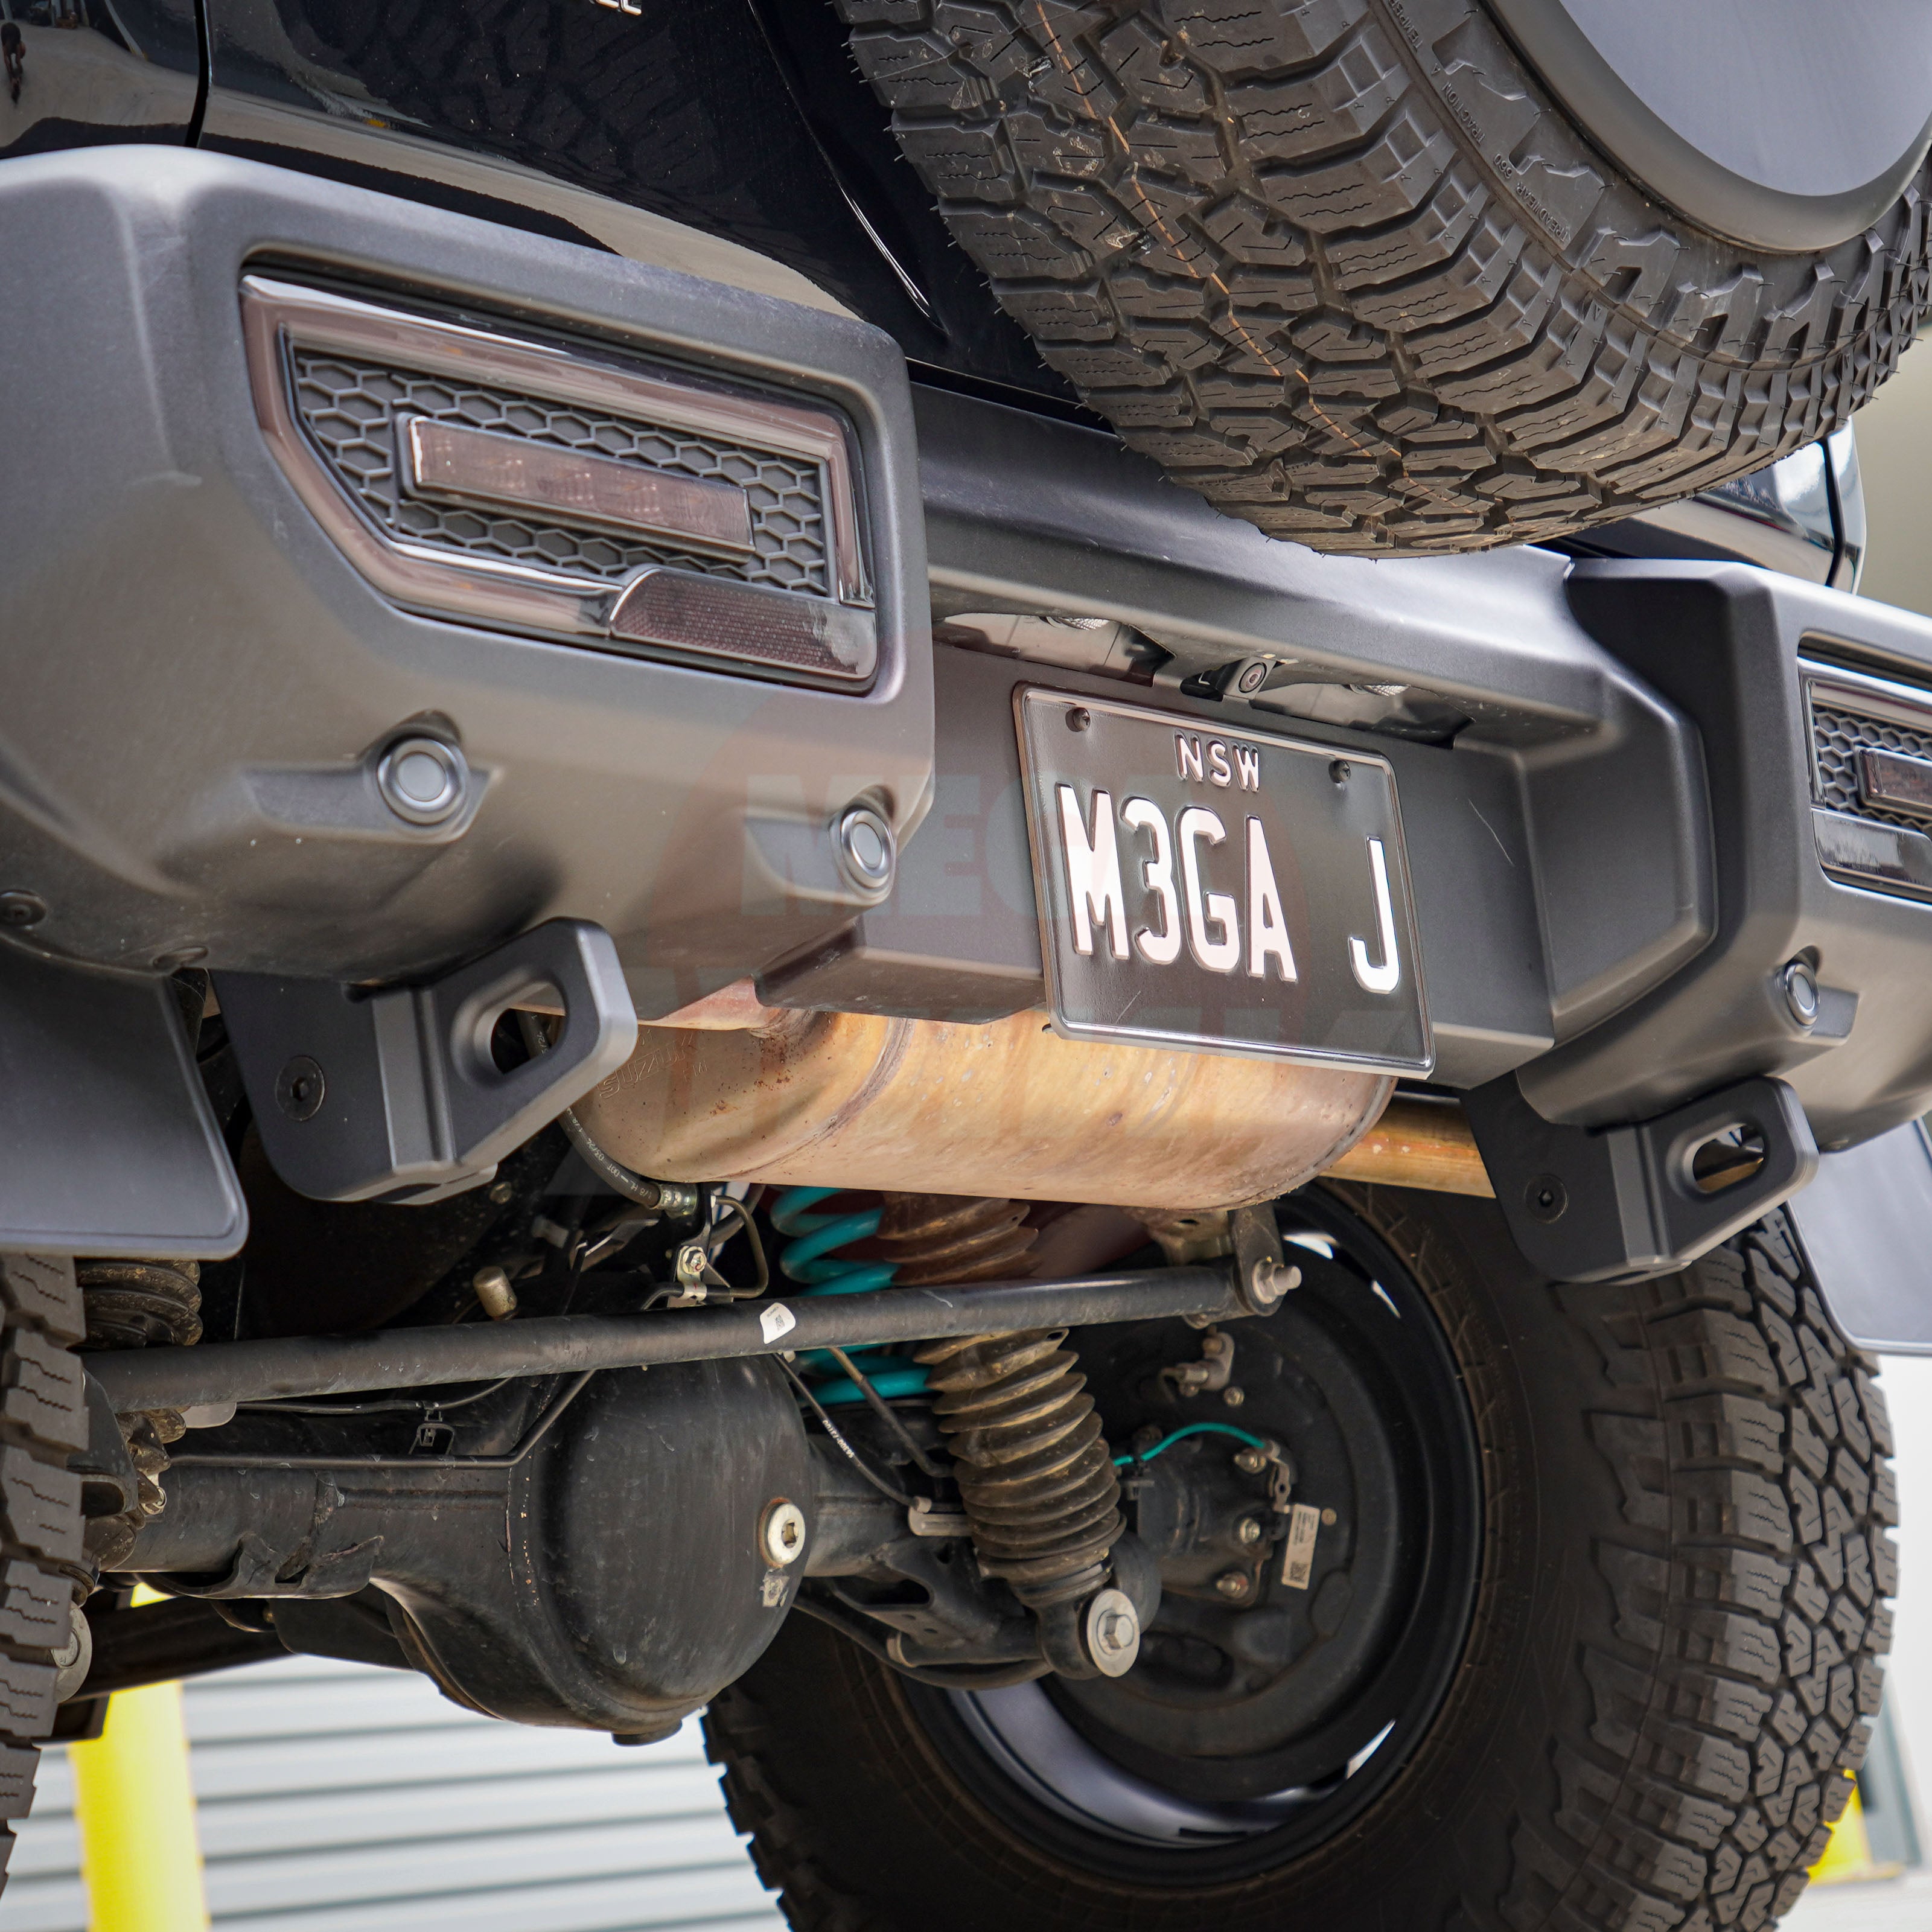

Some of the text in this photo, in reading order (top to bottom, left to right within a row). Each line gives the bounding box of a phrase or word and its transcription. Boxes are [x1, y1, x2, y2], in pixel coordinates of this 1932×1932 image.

[1441, 81, 1485, 144] TRACTION
[1493, 153, 1513, 179] 660
[1175, 730, 1260, 792] NSW
[1055, 783, 1400, 994] M3GA J
[599, 1033, 699, 1100] SUZUK
